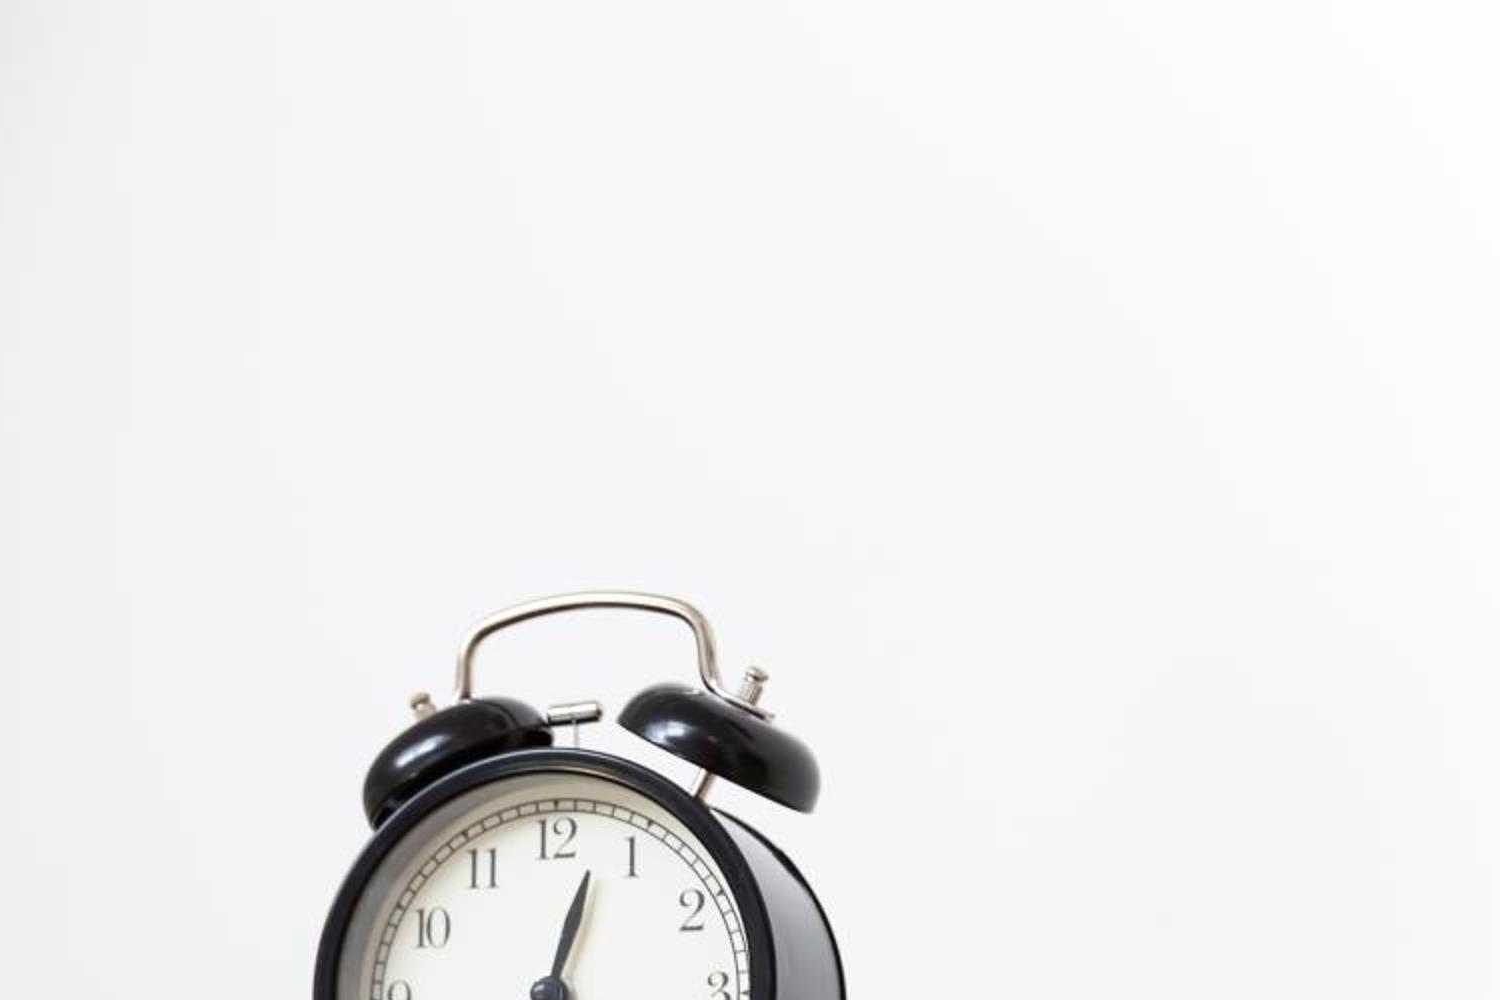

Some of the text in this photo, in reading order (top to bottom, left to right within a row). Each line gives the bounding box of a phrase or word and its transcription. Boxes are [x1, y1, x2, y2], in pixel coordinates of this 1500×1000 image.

[536, 816, 578, 861] 12
[624, 834, 638, 879] 1
[466, 847, 500, 890] 11
[414, 906, 452, 950] 10
[678, 888, 706, 933] 2
